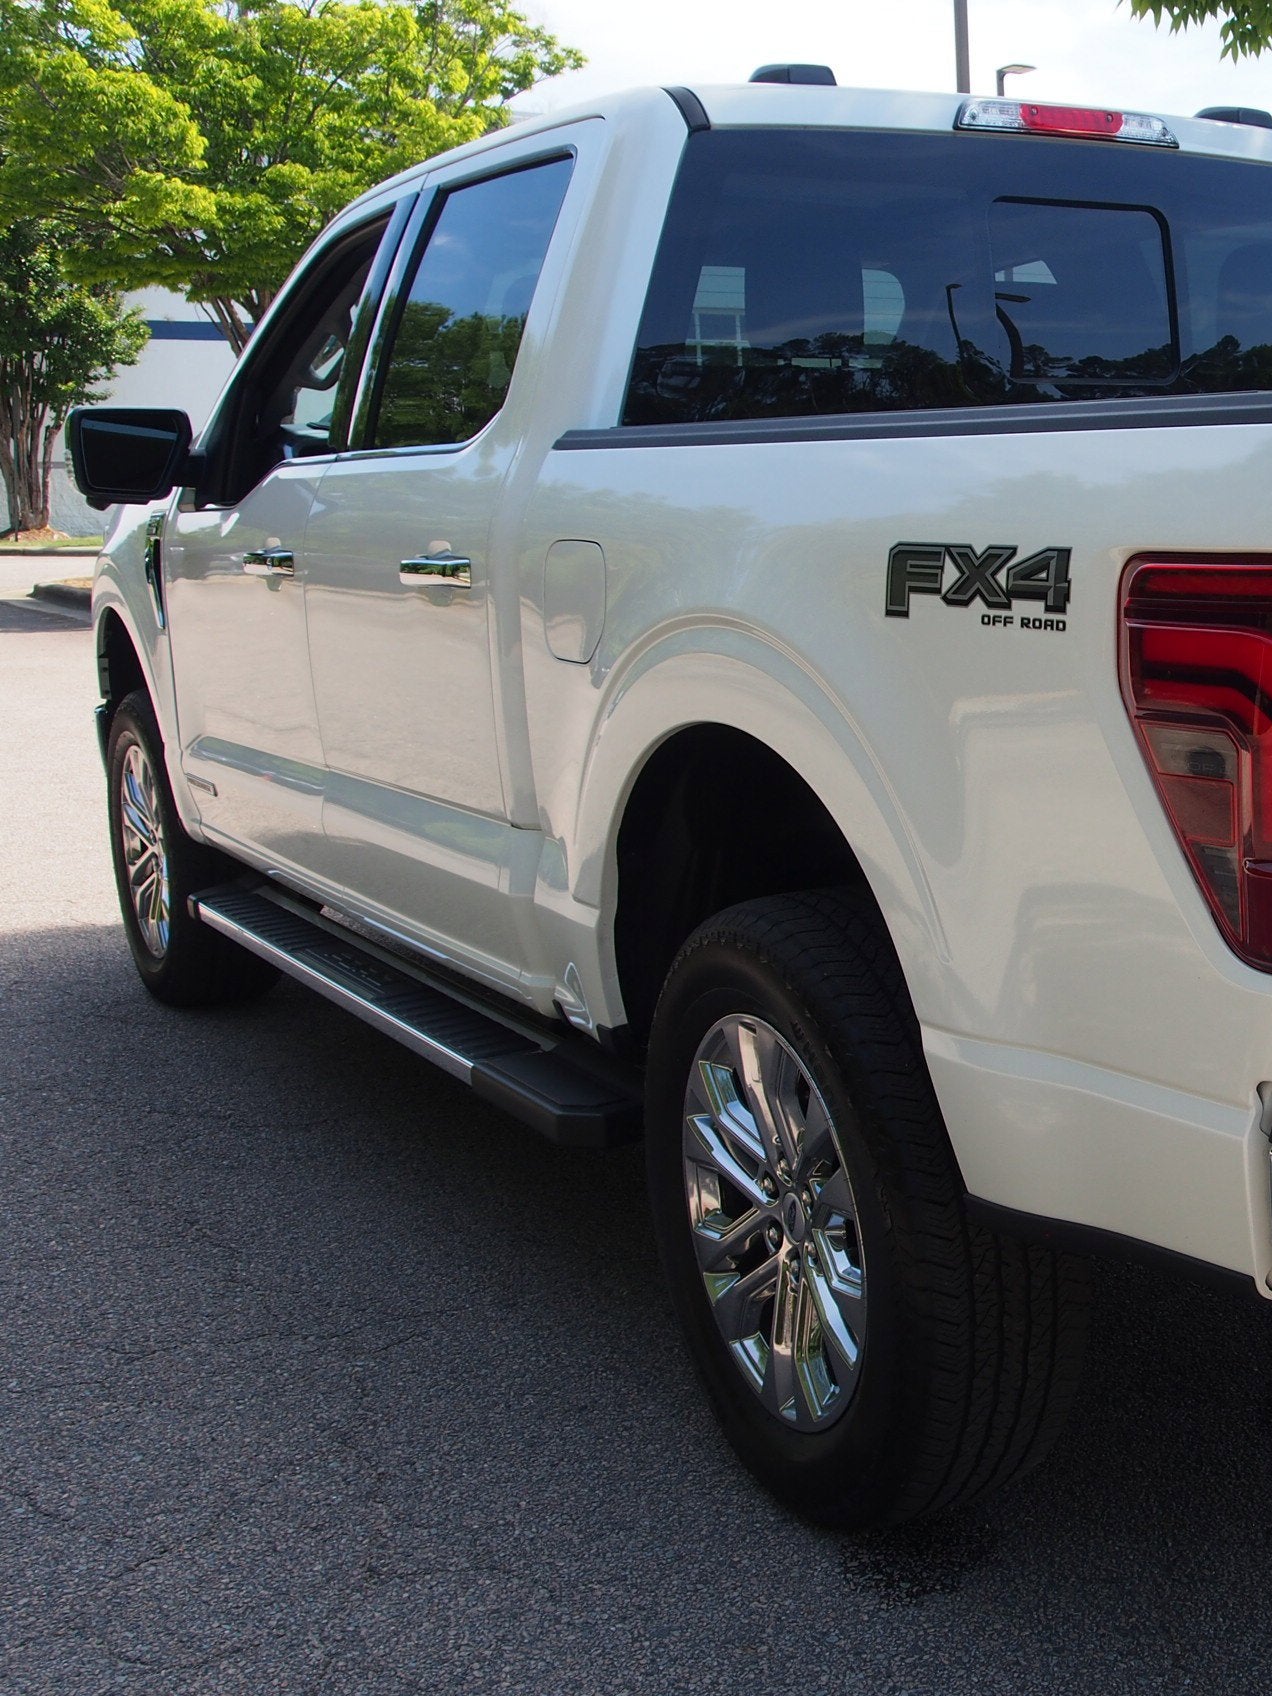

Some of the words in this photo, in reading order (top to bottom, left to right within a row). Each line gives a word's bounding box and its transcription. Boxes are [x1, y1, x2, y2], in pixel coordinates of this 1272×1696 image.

[885, 541, 1073, 618] FX4
[981, 614, 1014, 627] OFF
[1020, 617, 1067, 631] ROAD
